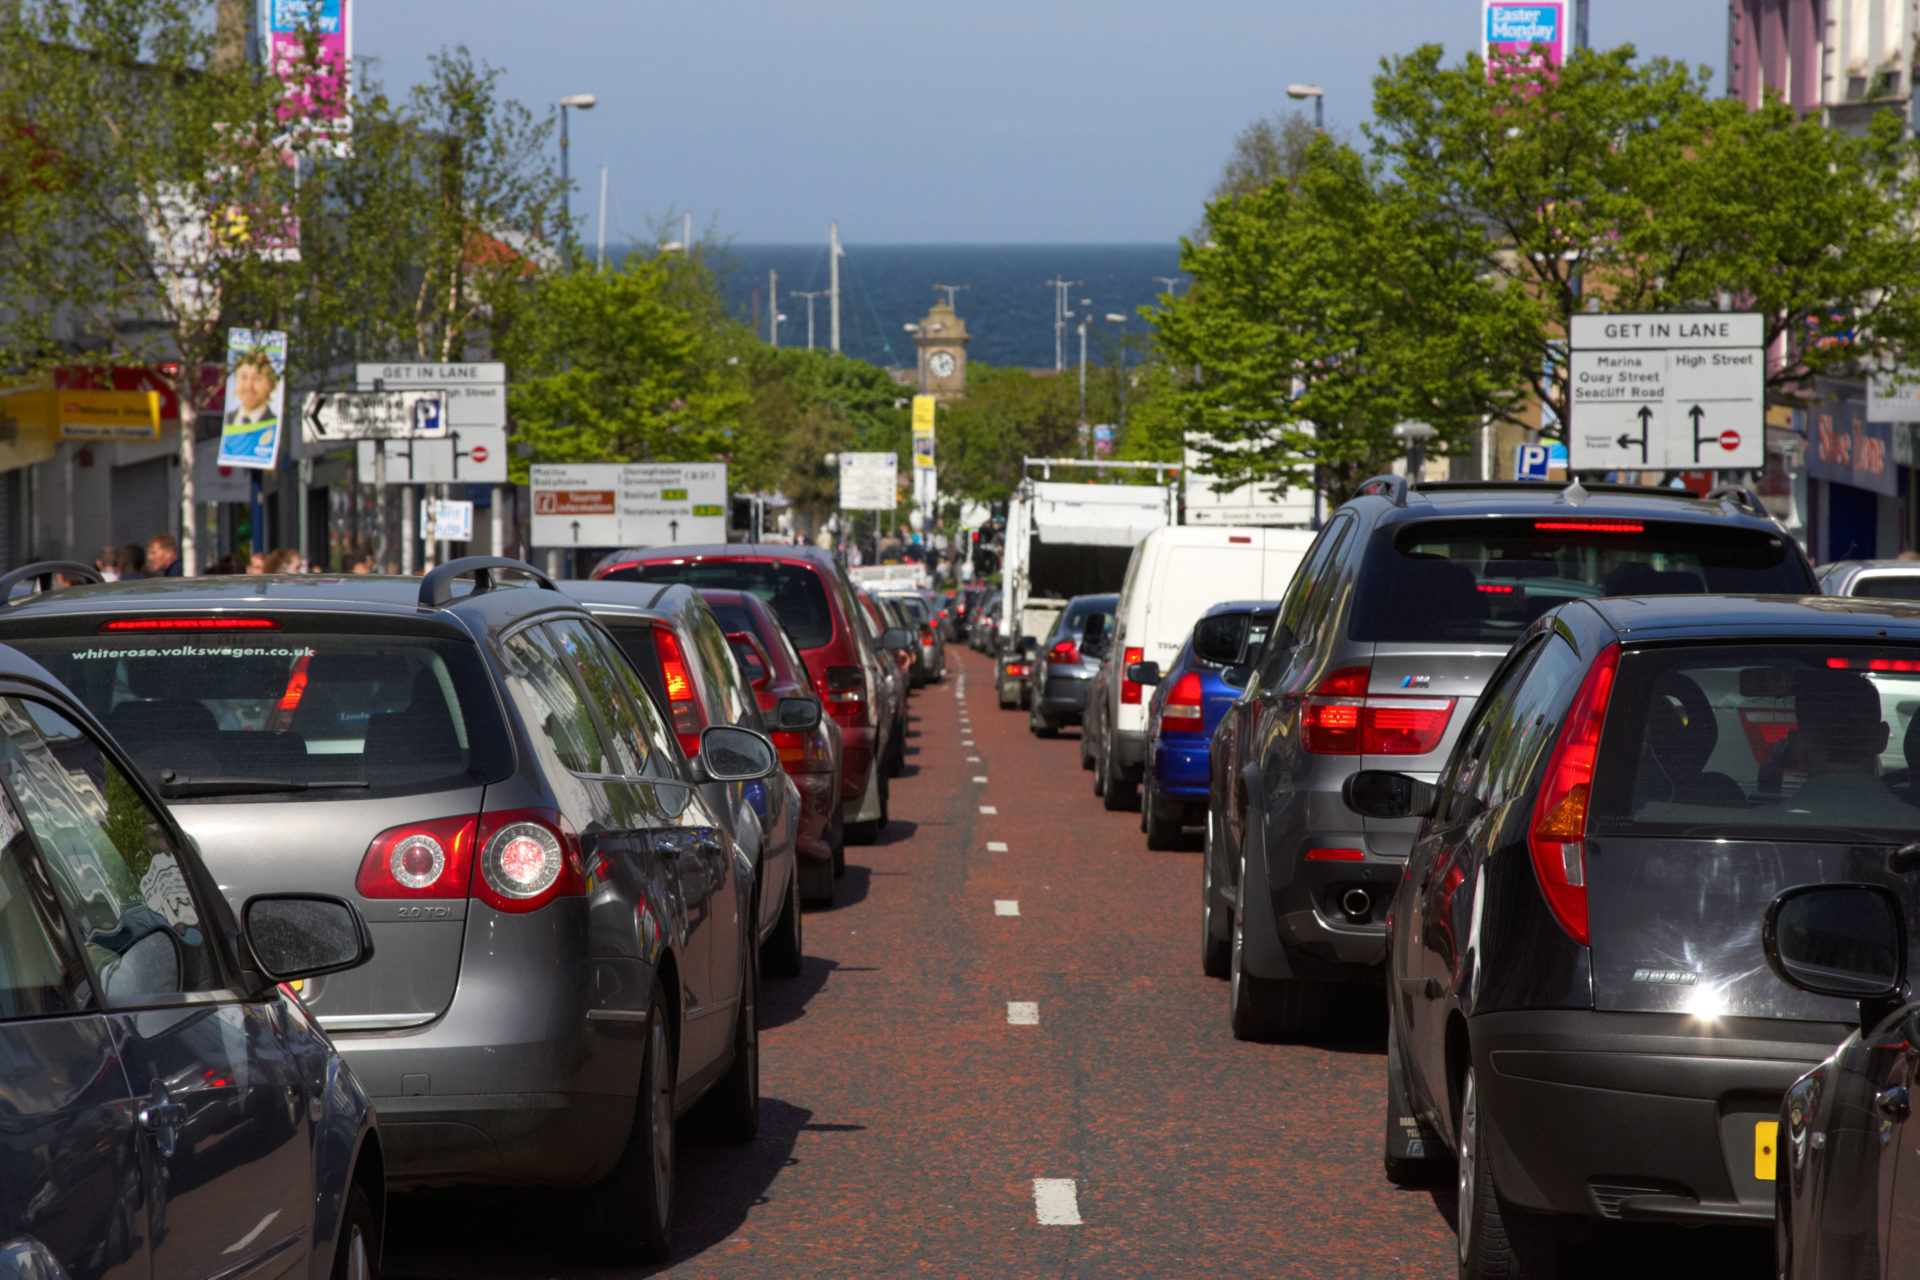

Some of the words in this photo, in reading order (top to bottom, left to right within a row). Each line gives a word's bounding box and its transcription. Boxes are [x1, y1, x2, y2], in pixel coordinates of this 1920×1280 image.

[1492, 7, 1541, 22] Easter
[1492, 21, 1554, 41] Monday
[1605, 323, 1642, 338] GET
[1650, 323, 1670, 337] IN
[1679, 322, 1731, 338] LANE
[1597, 356, 1642, 367] Marina
[1676, 354, 1706, 368] High
[1712, 353, 1753, 366] Street
[382, 367, 411, 379] GET
[416, 366, 434, 378] IN
[438, 366, 478, 378] LANE
[1579, 372, 1613, 384] Quay
[1618, 370, 1660, 382] Street
[464, 388, 496, 397] Street
[1575, 386, 1626, 398] Seacliff
[1631, 385, 1665, 398] Road
[1522, 446, 1545, 474] P
[72, 645, 316, 660] whiterose.volkswagen.co.uk
[399, 906, 421, 919] 2.0
[424, 906, 451, 918] TDI
[1631, 968, 1697, 985] FIAT
